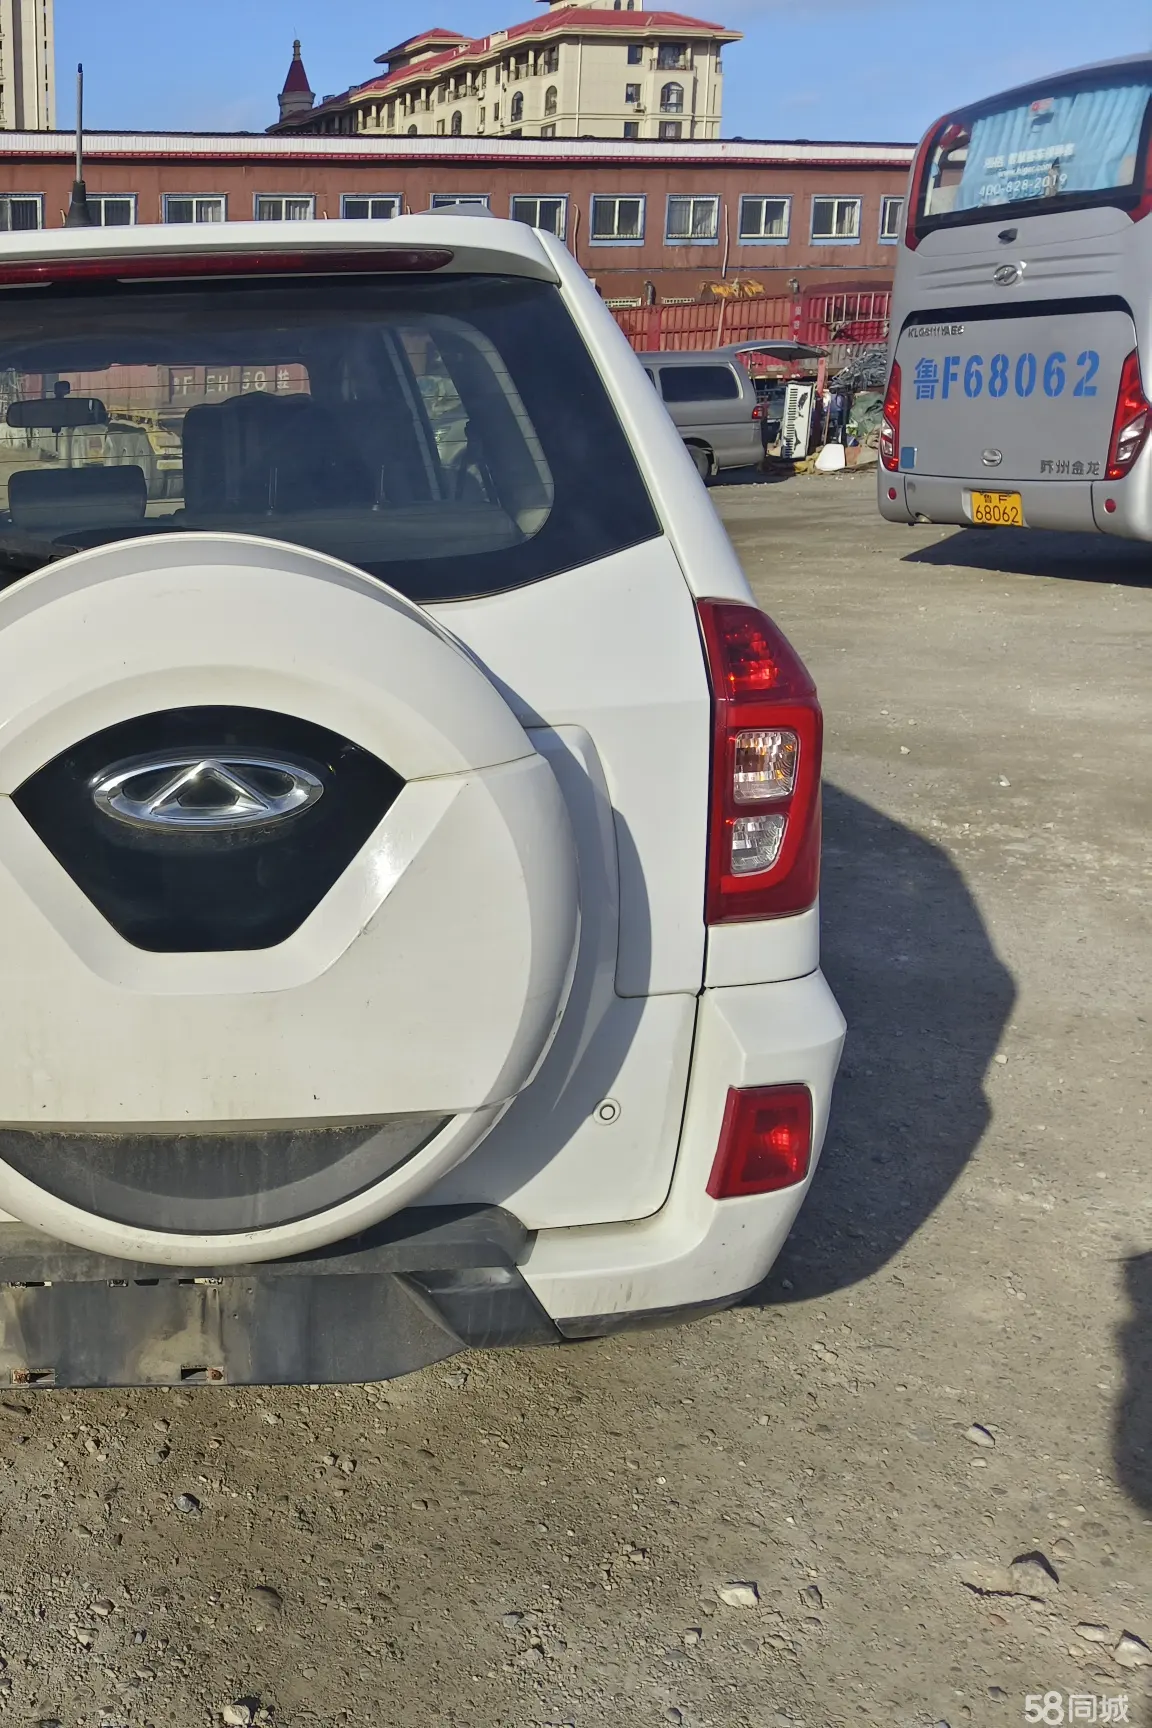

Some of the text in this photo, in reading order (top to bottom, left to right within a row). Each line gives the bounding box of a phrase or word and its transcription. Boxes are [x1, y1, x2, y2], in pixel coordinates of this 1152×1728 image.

[979, 173, 1068, 197] 400-828-2019
[913, 350, 1100, 400] 鲁F68062
[975, 505, 1019, 524] 68062
